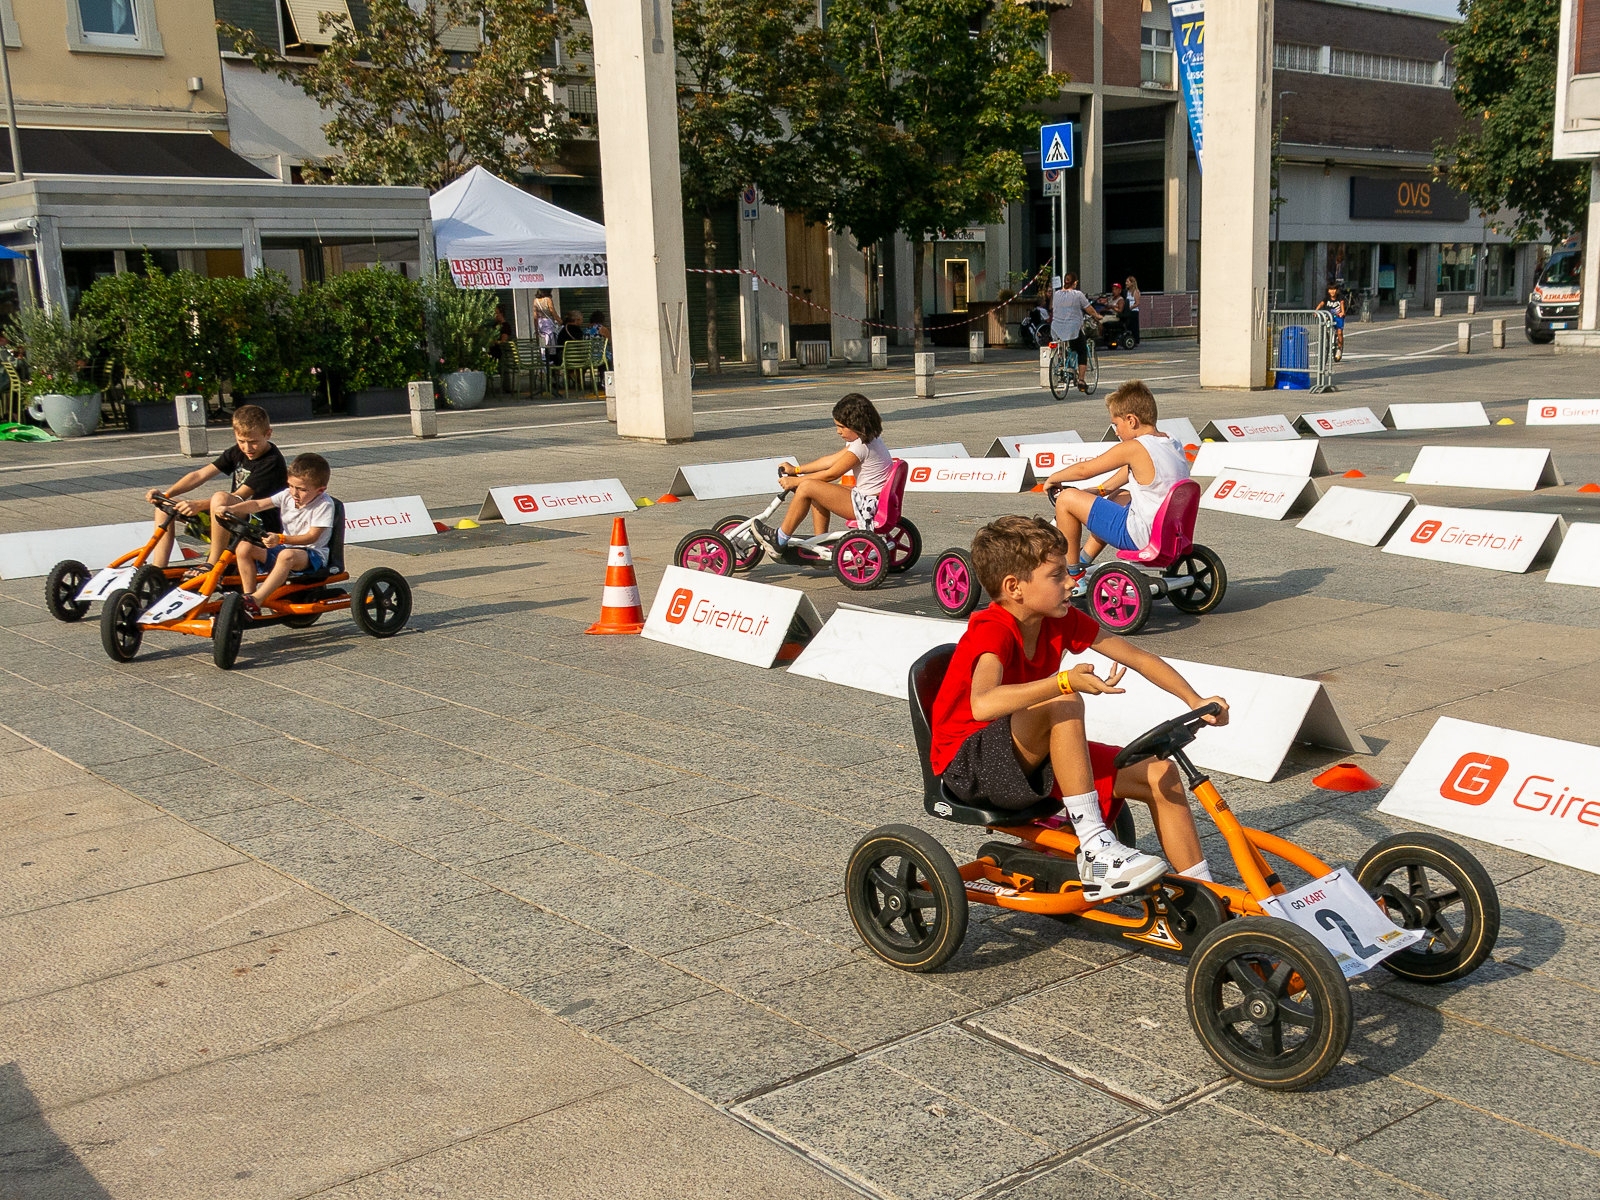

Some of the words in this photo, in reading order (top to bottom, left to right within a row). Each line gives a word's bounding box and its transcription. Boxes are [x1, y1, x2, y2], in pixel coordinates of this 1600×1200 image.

[1398, 182, 1430, 207] OVS
[452, 258, 503, 274] LISSONE
[461, 272, 495, 287] FUORI
[495, 272, 512, 287] GP
[1243, 425, 1286, 435] Giretto.it
[1331, 418, 1371, 428] Giretto.it
[936, 469, 1007, 481] Giretto.it
[541, 492, 613, 508] Giretto.it
[1232, 484, 1285, 503] Giretto.it
[344, 512, 411, 529] iretto.it
[1440, 526, 1523, 551] Giretto.it
[97, 576, 118, 595] 1
[693, 599, 769, 636] Giretto.it
[1513, 775, 1600, 827] Gire
[1291, 899, 1306, 910] GO
[1302, 889, 1327, 906] KART
[1315, 908, 1383, 960] 2
